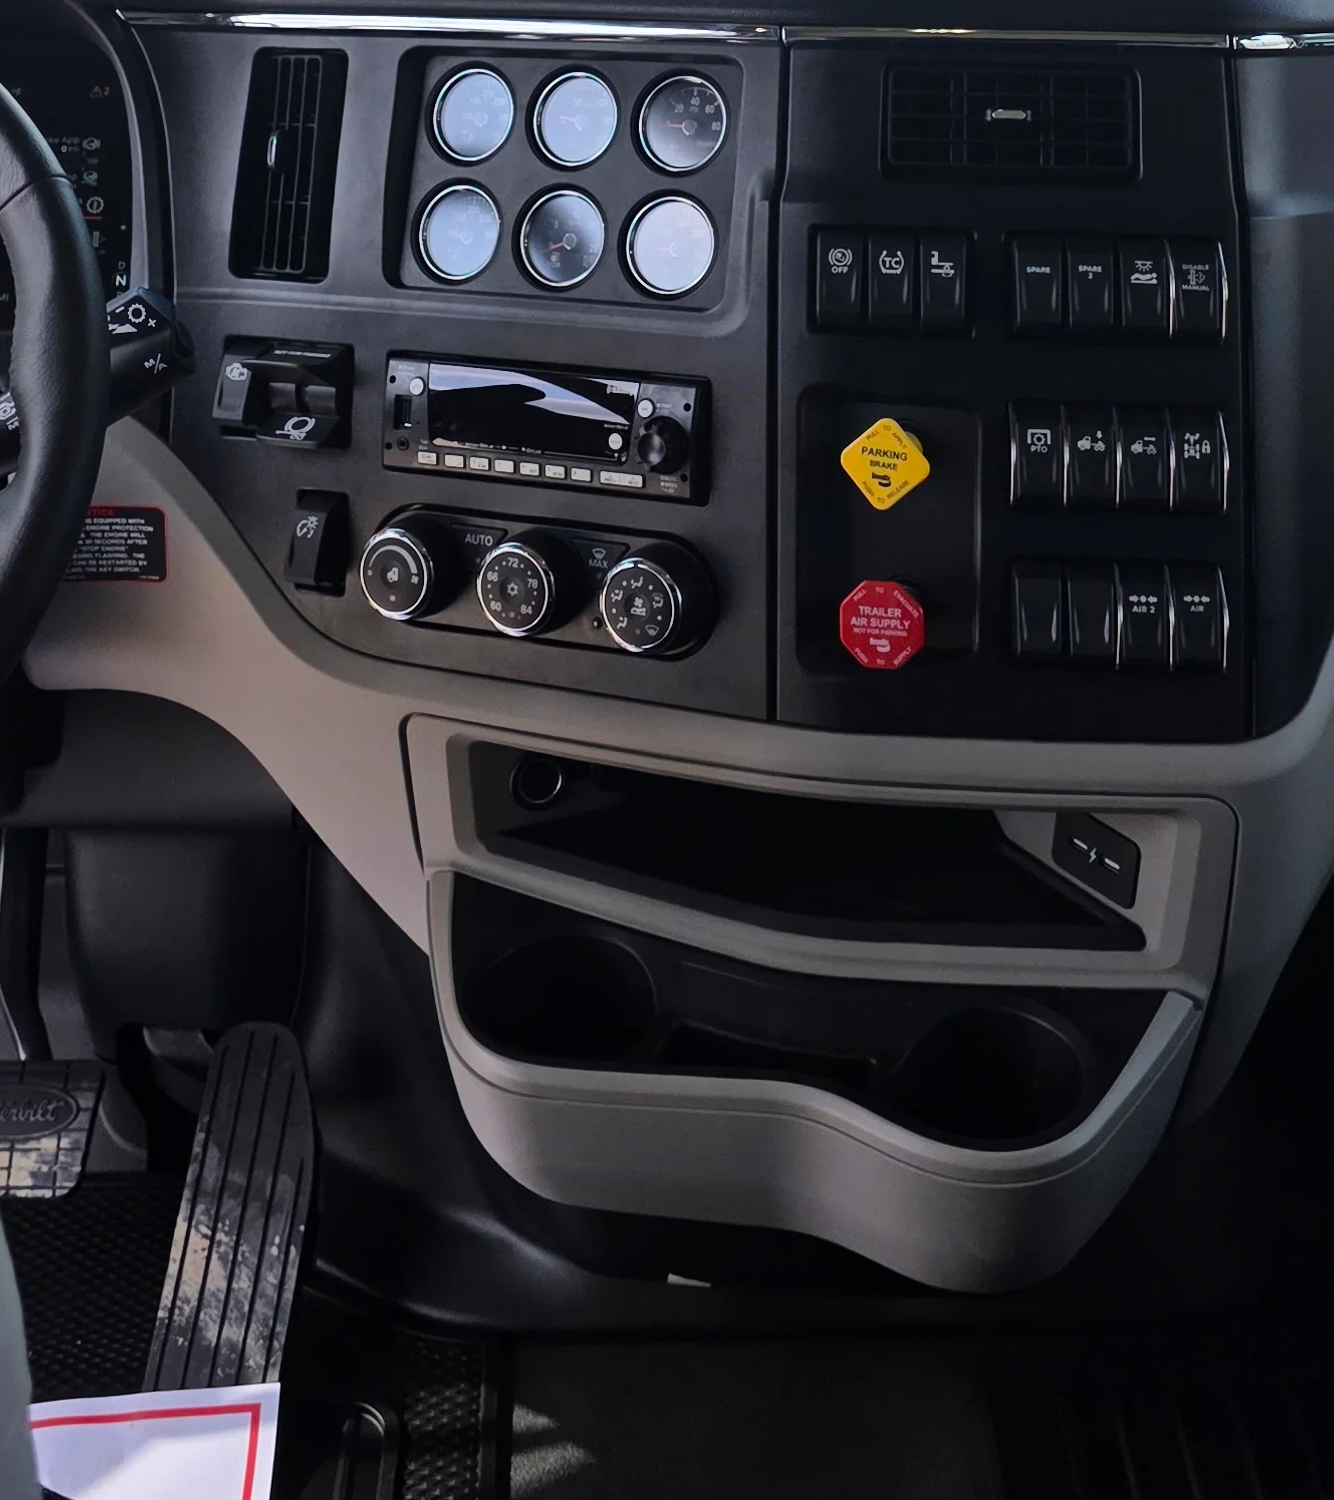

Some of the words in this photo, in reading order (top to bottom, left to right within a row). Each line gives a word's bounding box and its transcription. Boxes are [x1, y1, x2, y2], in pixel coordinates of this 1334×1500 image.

[883, 257, 900, 268] TC
[1078, 264, 1102, 273] SPARE
[831, 266, 849, 274] OFF
[1026, 266, 1051, 274] SPARE
[115, 275, 127, 288] N
[861, 446, 908, 462] PARKING
[1030, 444, 1048, 453] PTO
[869, 460, 898, 471] BRAKE
[464, 533, 494, 547] AUTO
[507, 556, 519, 569] 72
[588, 558, 609, 570] MAX
[486, 571, 499, 583] 66
[526, 577, 538, 590] 78
[489, 600, 502, 612] 60
[520, 603, 533, 616] 84
[858, 605, 902, 618] TRAILER
[1132, 605, 1148, 613] AIR
[1190, 605, 1205, 613] AIR
[850, 615, 867, 627] AIR
[869, 617, 911, 630] SUPPLY
